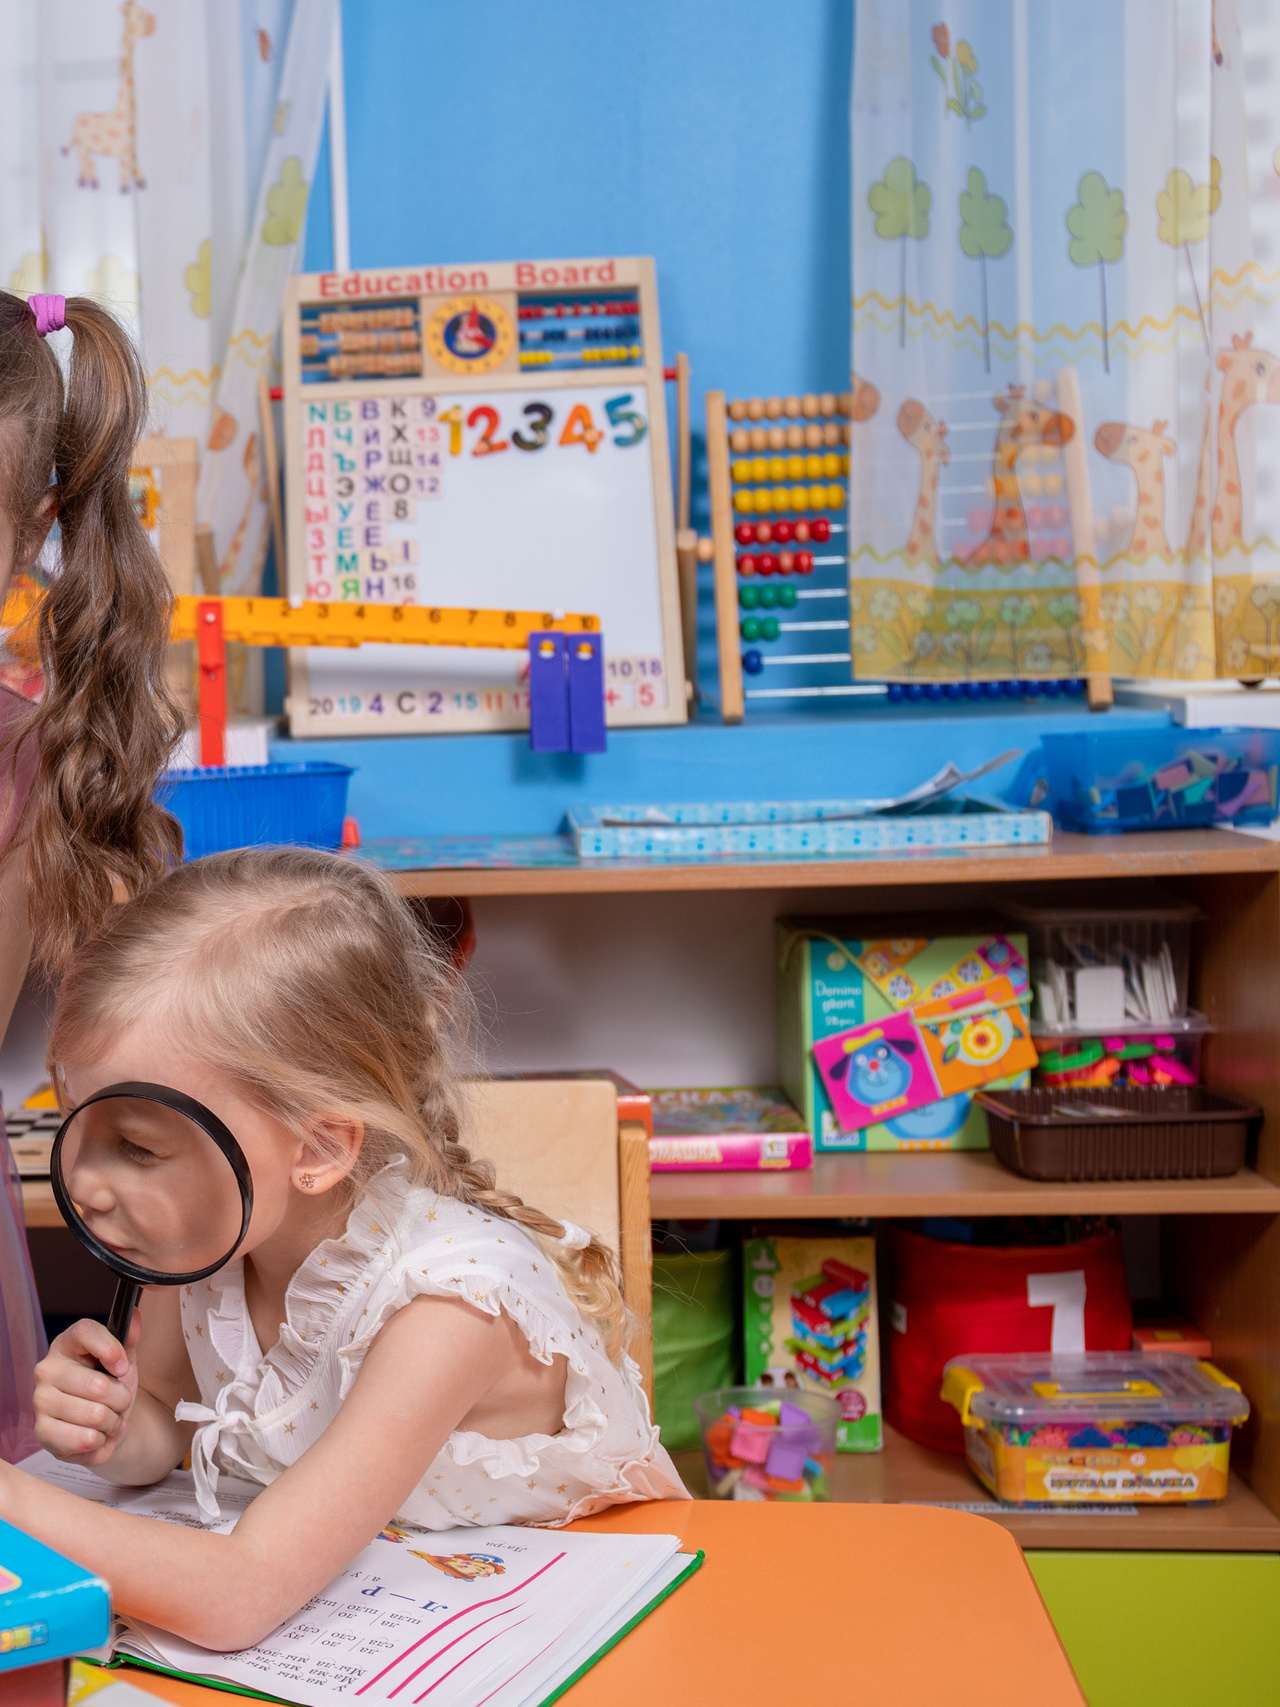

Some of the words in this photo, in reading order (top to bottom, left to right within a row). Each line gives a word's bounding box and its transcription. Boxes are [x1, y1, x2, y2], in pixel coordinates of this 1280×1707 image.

[320, 267, 488, 298] Education
[515, 261, 616, 287] Board
[421, 396, 437, 418] 9
[393, 498, 409, 521] 8
[306, 580, 332, 600] Ю
[341, 578, 361, 600] Я
[392, 574, 416, 591] 16
[354, 605, 366, 621] 4
[429, 607, 442, 624] 6
[467, 609, 479, 626] 7
[504, 611, 517, 627] 8
[609, 659, 633, 677] 10
[638, 658, 663, 676] 18
[308, 697, 334, 716] 20
[337, 695, 363, 714] 19
[367, 693, 385, 715] 4
[427, 691, 445, 715] 2
[453, 691, 479, 711] 15
[639, 683, 656, 708] 5
[815, 979, 862, 997] Domino
[346, 1603, 380, 1616] шло
[330, 1632, 357, 1642] сло
[368, 1639, 395, 1650] сла
[255, 1656, 303, 1672] мы-ла
[277, 1670, 328, 1688] ма-мы
[308, 1668, 358, 1686] Ма-ма
